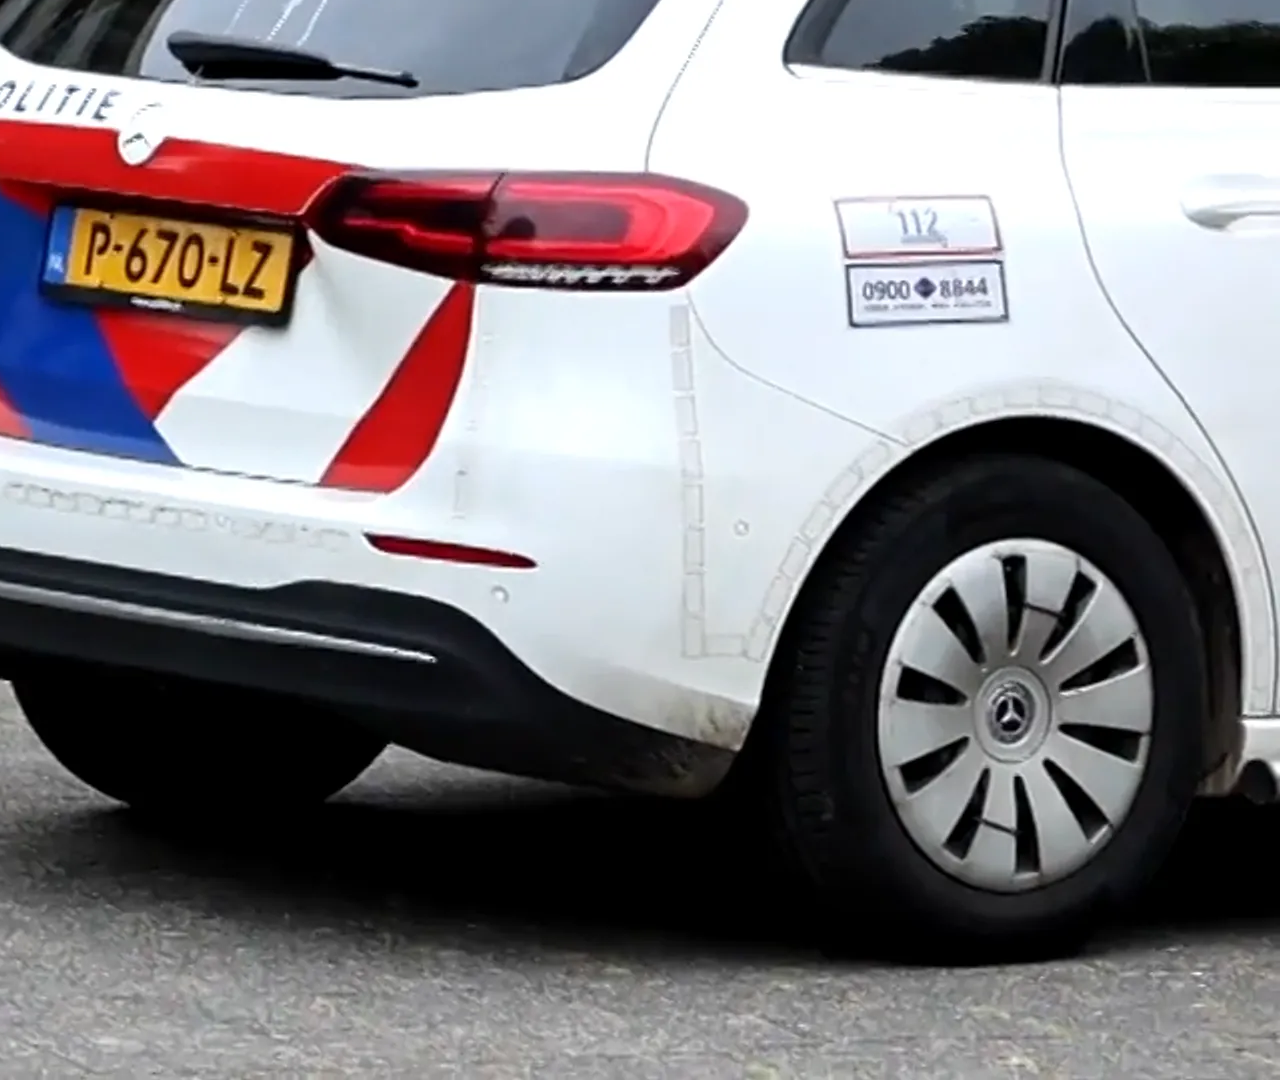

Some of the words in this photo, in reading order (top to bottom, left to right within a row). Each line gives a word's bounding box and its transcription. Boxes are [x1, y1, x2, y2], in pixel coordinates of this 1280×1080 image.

[897, 207, 938, 235] 112
[84, 221, 274, 299] P-670-LZ
[862, 280, 911, 300] 0900
[939, 277, 988, 299] 8844
